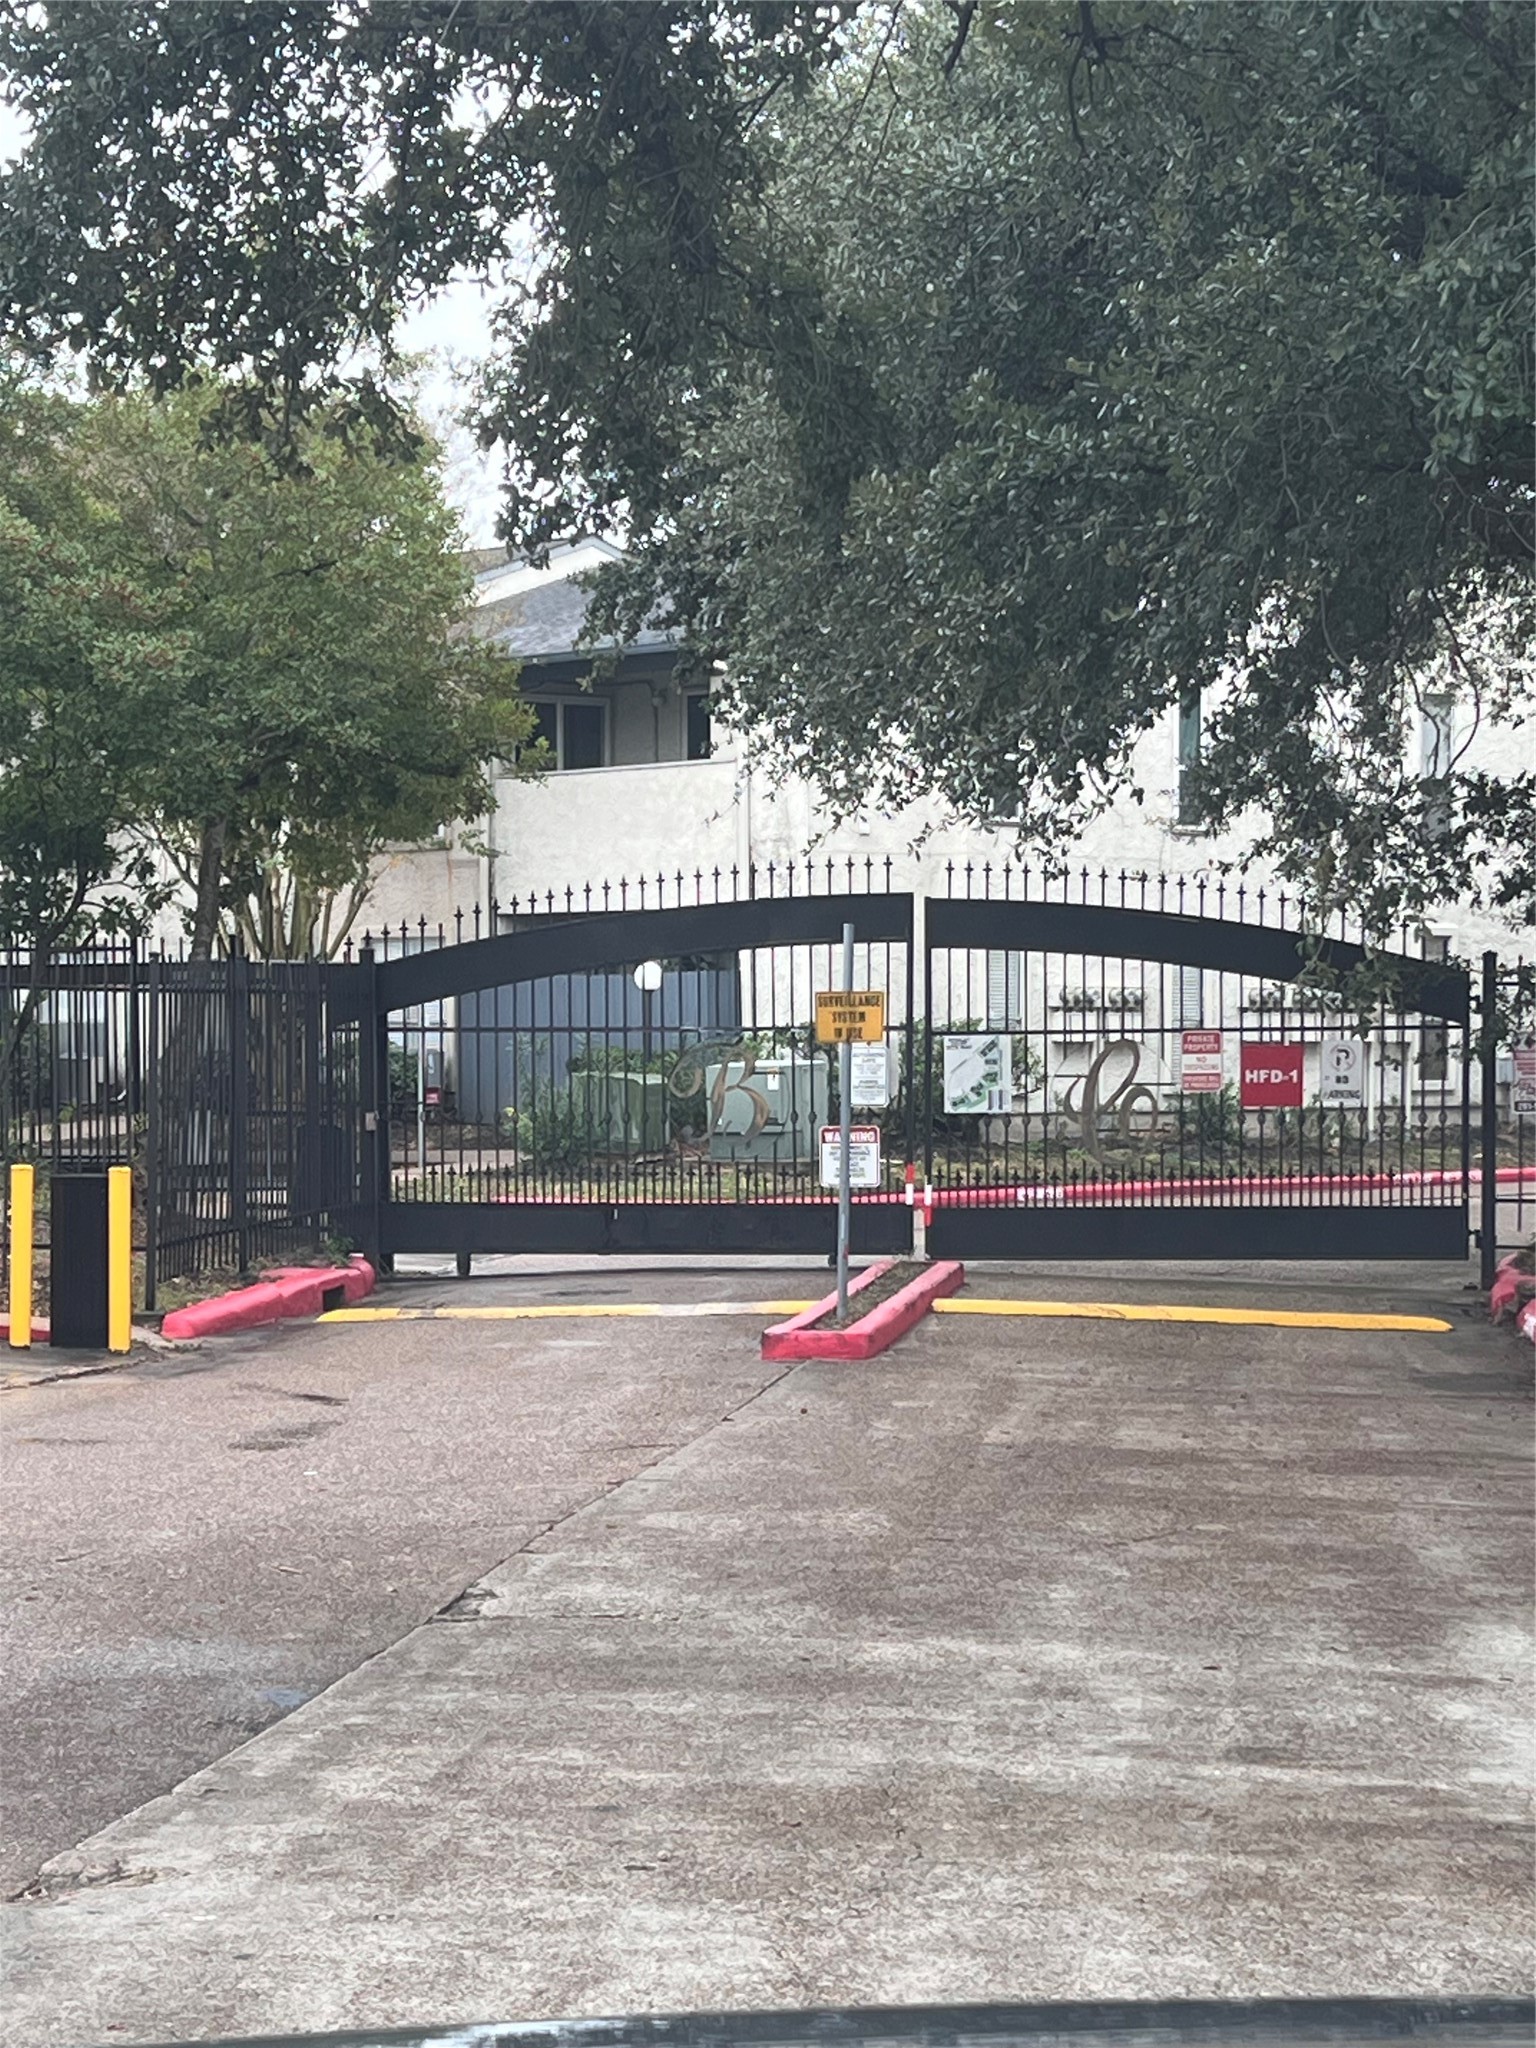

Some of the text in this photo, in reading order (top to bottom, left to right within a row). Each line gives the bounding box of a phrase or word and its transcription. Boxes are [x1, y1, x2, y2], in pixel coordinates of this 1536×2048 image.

[818, 995, 880, 1007] SURVEILLANCE
[832, 1011, 866, 1023] SYSTEM
[1245, 1069, 1298, 1084] HFD-1
[824, 1131, 876, 1143] WANING
